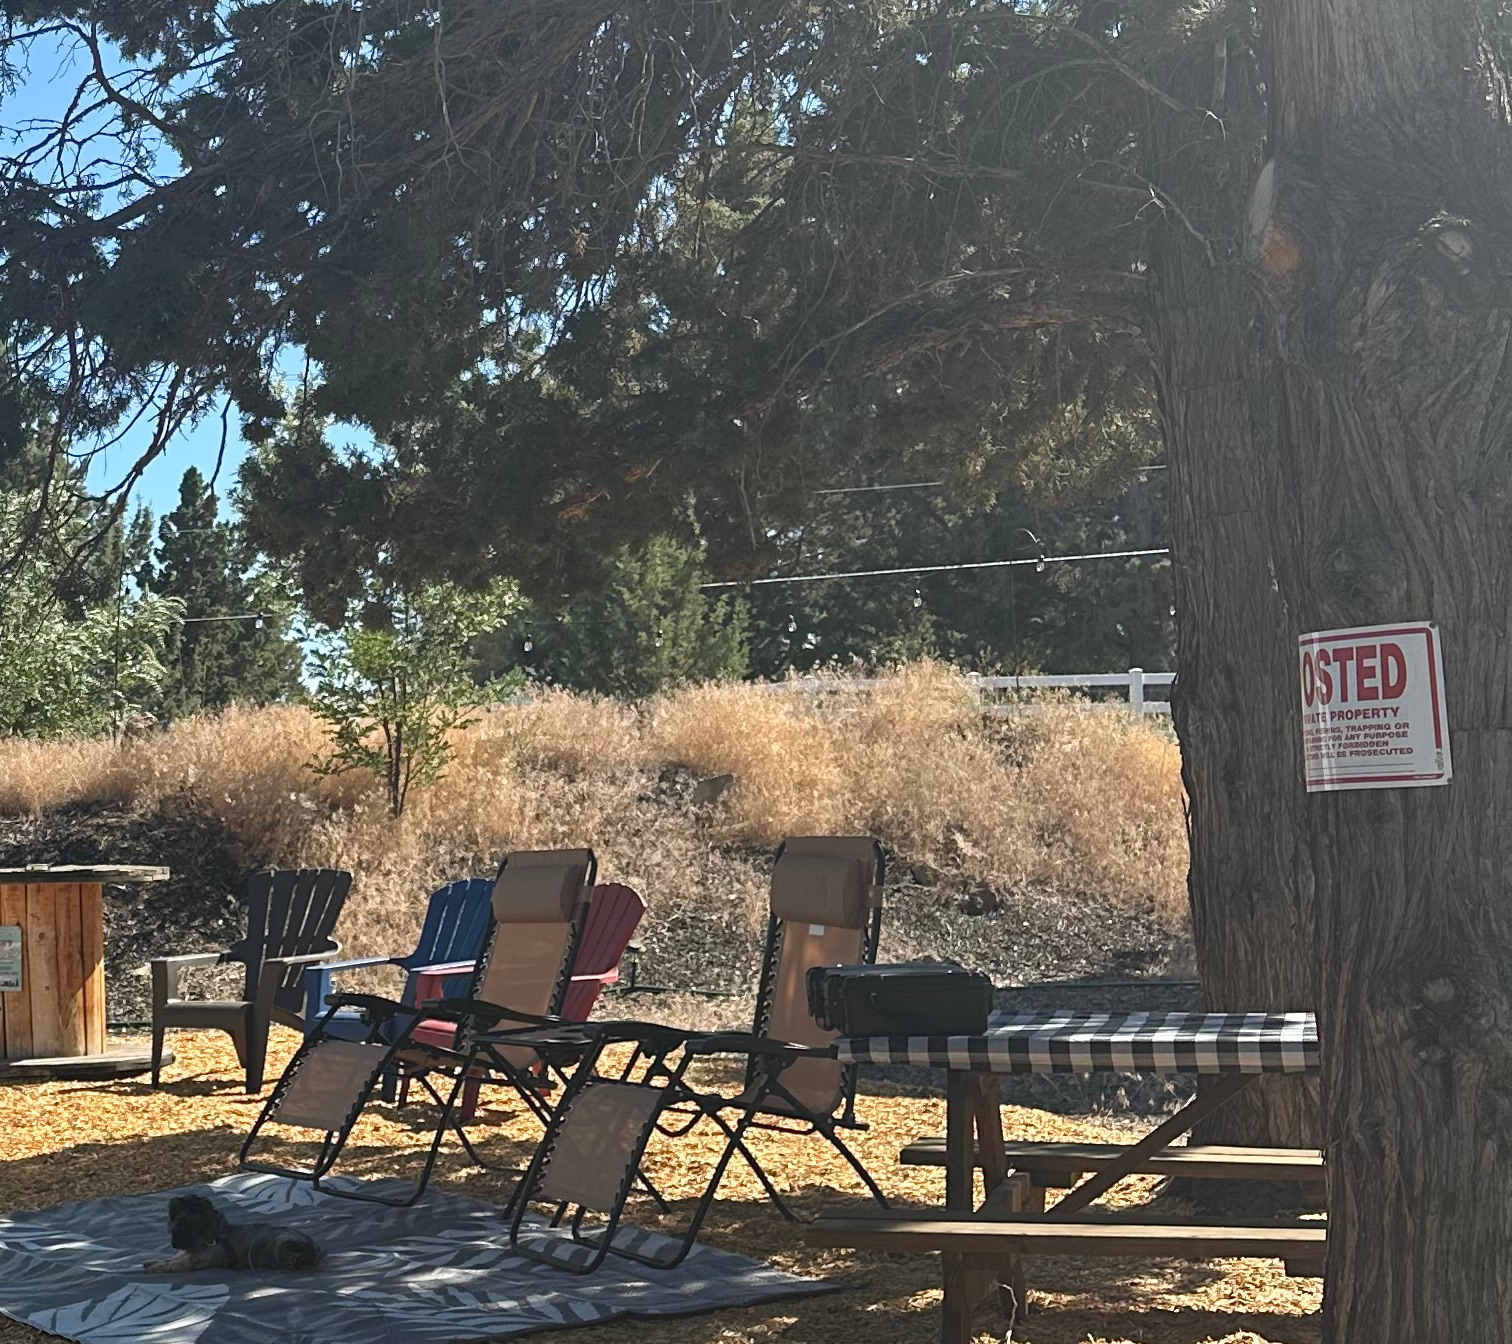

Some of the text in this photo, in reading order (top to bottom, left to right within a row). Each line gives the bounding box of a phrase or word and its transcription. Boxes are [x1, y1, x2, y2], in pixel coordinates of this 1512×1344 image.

[1302, 642, 1407, 707] OSTED
[1330, 707, 1400, 722] PROPERTY
[1346, 723, 1391, 733] TRAPPING
[1394, 722, 1410, 730] OR
[1344, 733, 1362, 742] ANY
[1363, 731, 1409, 740] PURPOSE
[1349, 747, 1414, 757] PROSECUTED
